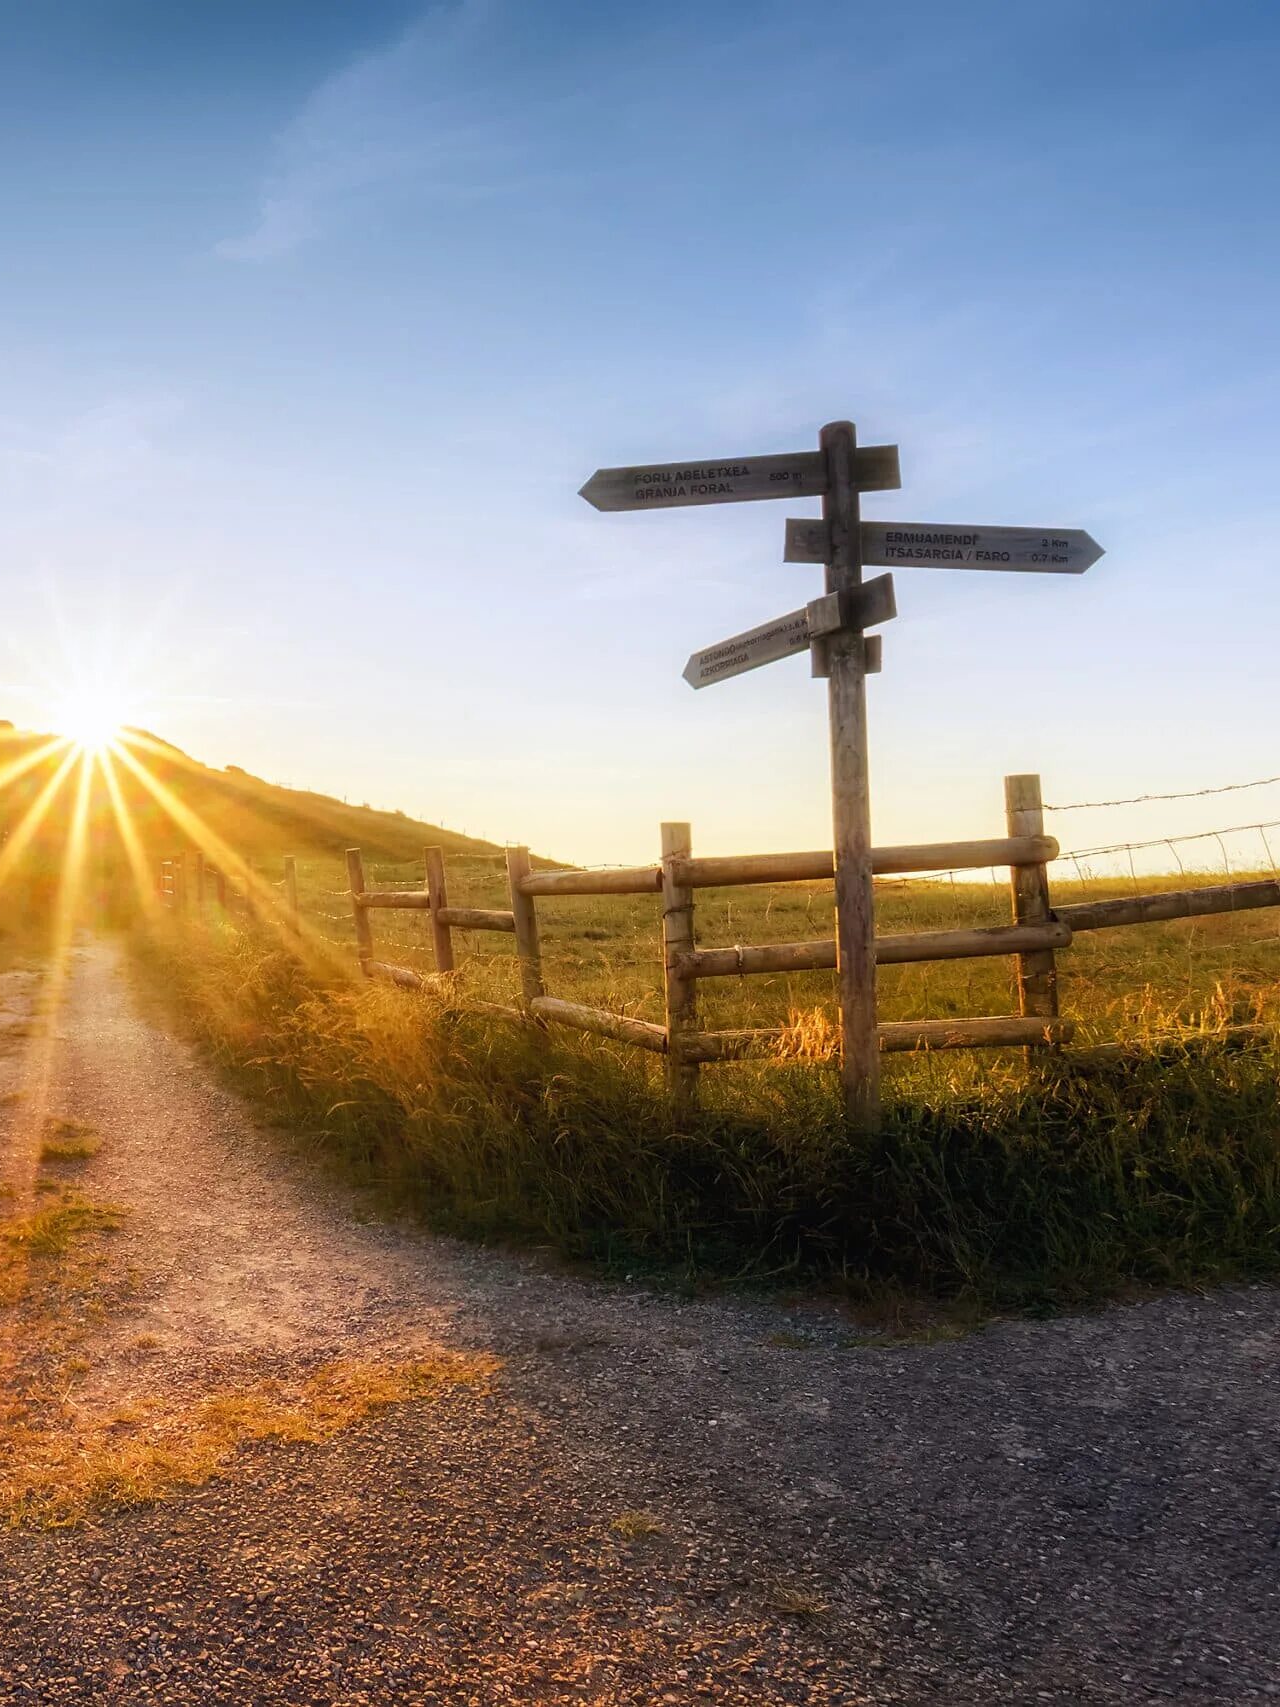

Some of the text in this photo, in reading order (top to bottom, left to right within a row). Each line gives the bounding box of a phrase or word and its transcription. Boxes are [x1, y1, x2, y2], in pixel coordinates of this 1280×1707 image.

[634, 472, 670, 484] FORU
[675, 466, 750, 482] ABELETXEA
[635, 482, 734, 500] GRANJA FORAL
[885, 547, 963, 560] ITSASARGIA
[966, 550, 972, 560] /
[975, 551, 1010, 562] FARO
